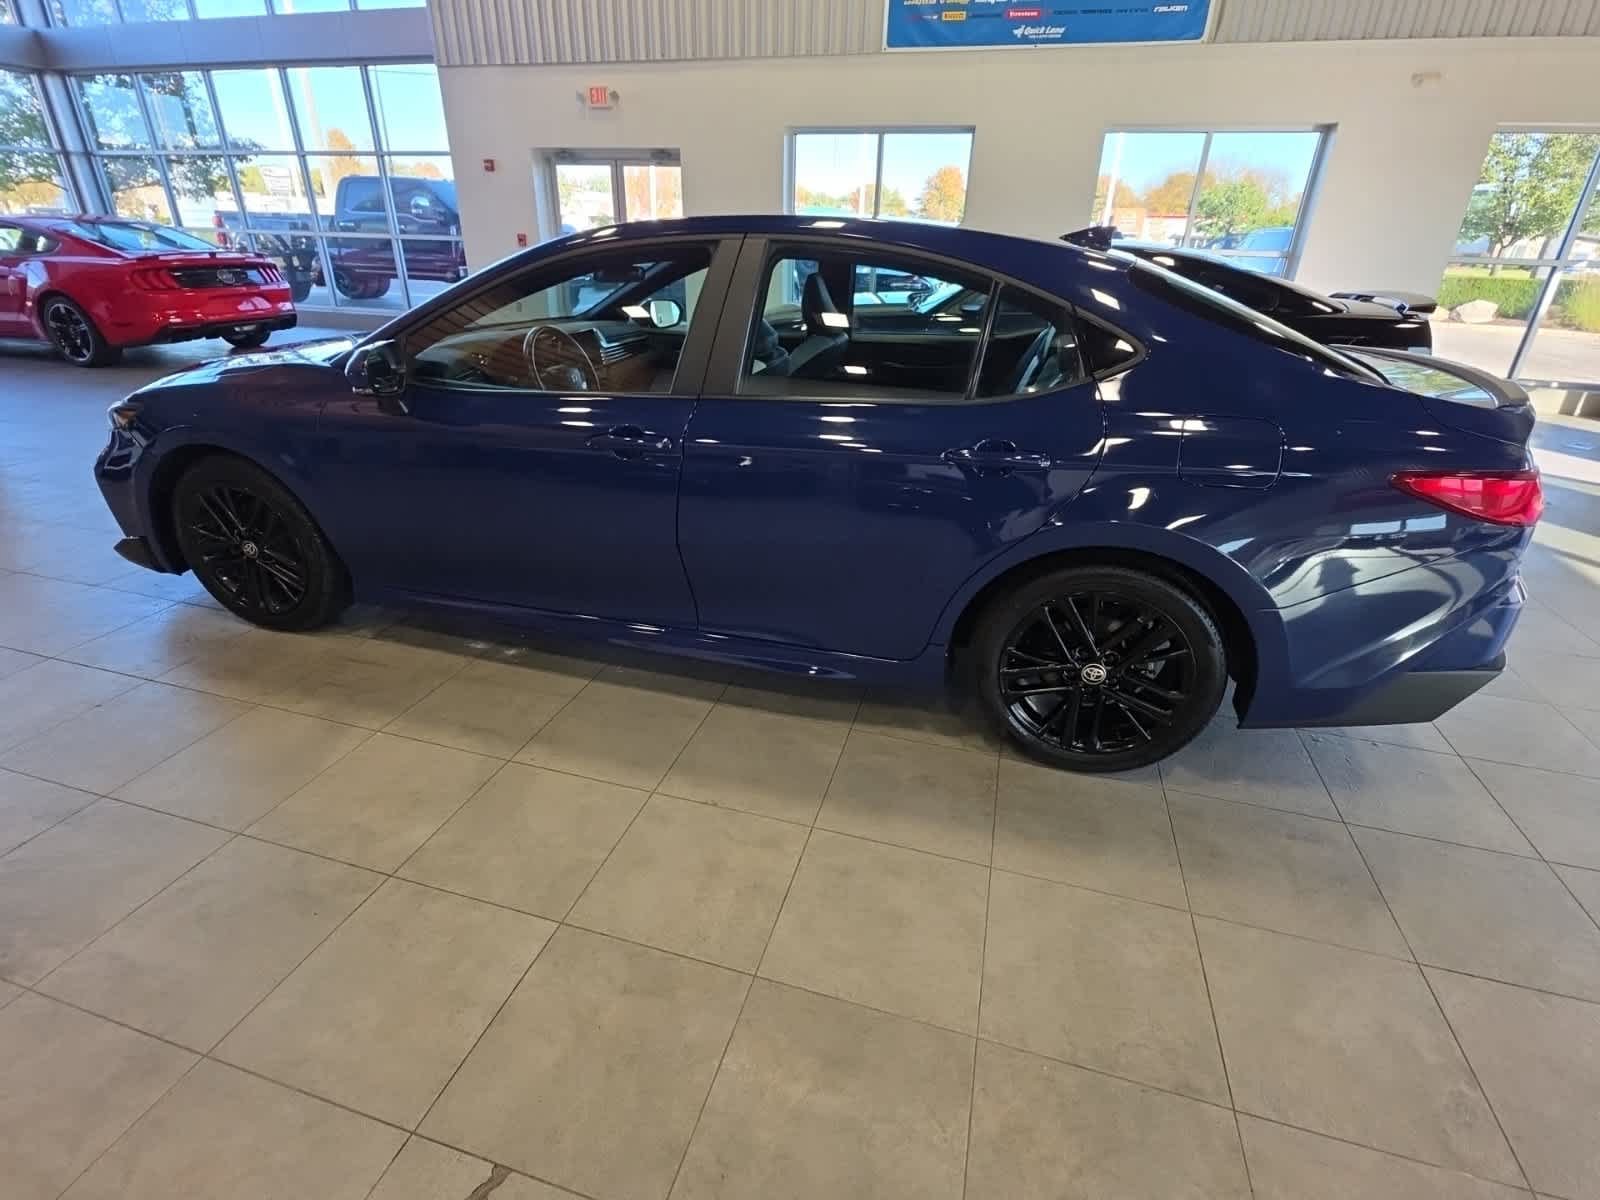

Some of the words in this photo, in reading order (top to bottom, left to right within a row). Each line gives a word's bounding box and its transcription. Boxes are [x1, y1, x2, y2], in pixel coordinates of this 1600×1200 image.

[1024, 25, 1045, 35] Quick
[1045, 25, 1066, 34] Lane
[590, 87, 608, 104] EXIT
